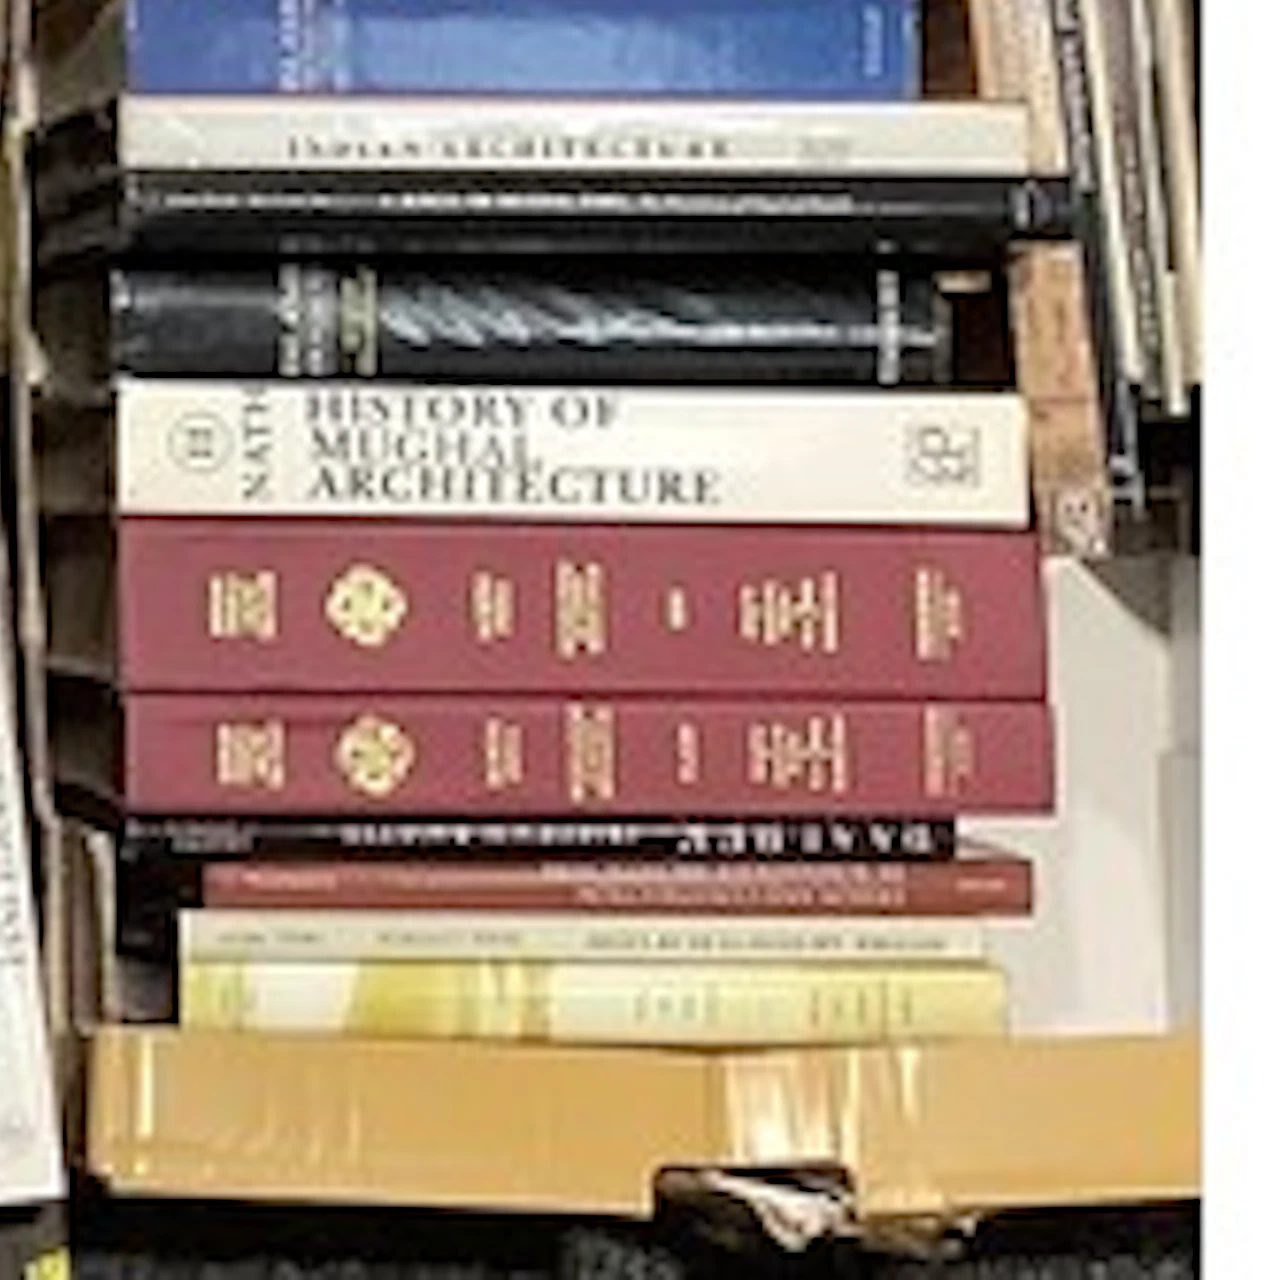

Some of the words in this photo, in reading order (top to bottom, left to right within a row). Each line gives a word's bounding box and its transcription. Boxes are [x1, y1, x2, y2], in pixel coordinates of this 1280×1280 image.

[304, 390, 534, 430] HISTORY
[551, 393, 620, 430] OF
[308, 426, 540, 468] MUGHAL
[308, 465, 723, 508] ARCHITECTURE
